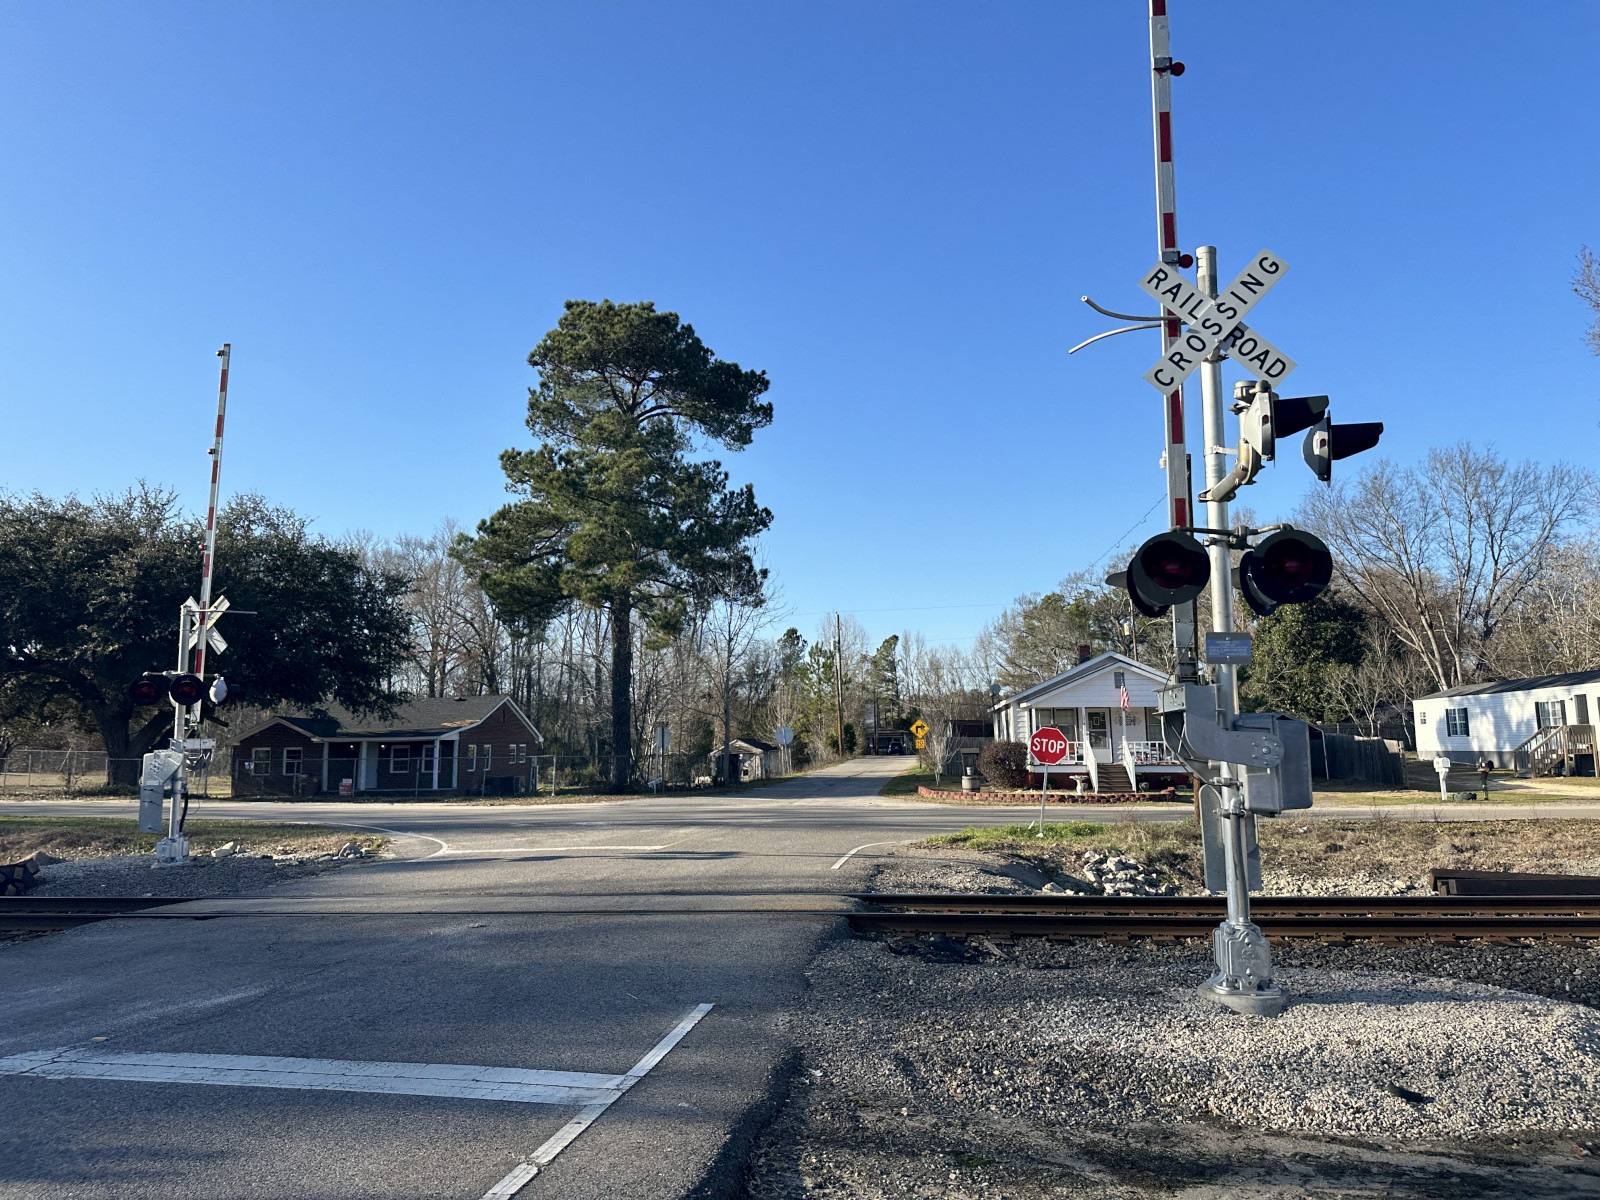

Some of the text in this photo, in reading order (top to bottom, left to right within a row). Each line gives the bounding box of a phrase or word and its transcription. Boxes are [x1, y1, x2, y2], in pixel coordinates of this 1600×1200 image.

[1147, 268, 1287, 379] RAIL ROAD
[1153, 256, 1279, 387] CROSSING
[1032, 737, 1065, 754] STOP
